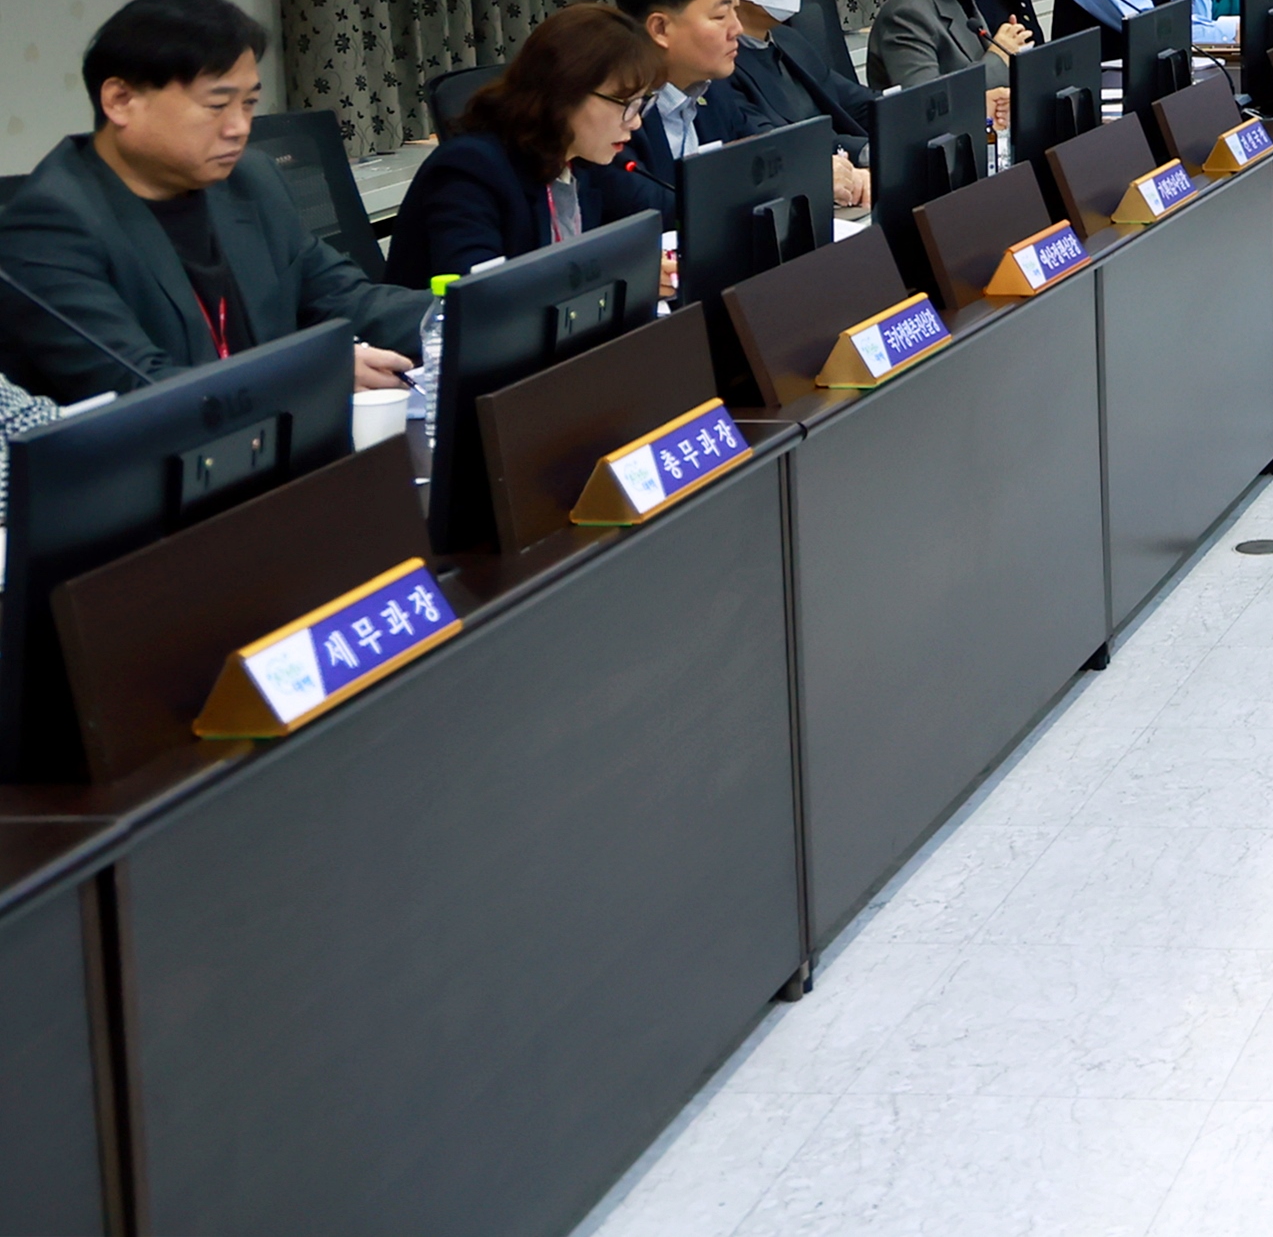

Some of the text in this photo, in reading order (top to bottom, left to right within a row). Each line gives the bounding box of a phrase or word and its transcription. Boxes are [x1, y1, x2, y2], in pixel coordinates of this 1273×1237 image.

[1039, 233, 1082, 270] 예산정책실장
[883, 307, 941, 354] 국가정책추진실장
[659, 418, 738, 480] 총무과장
[323, 583, 442, 669] 세무과장
